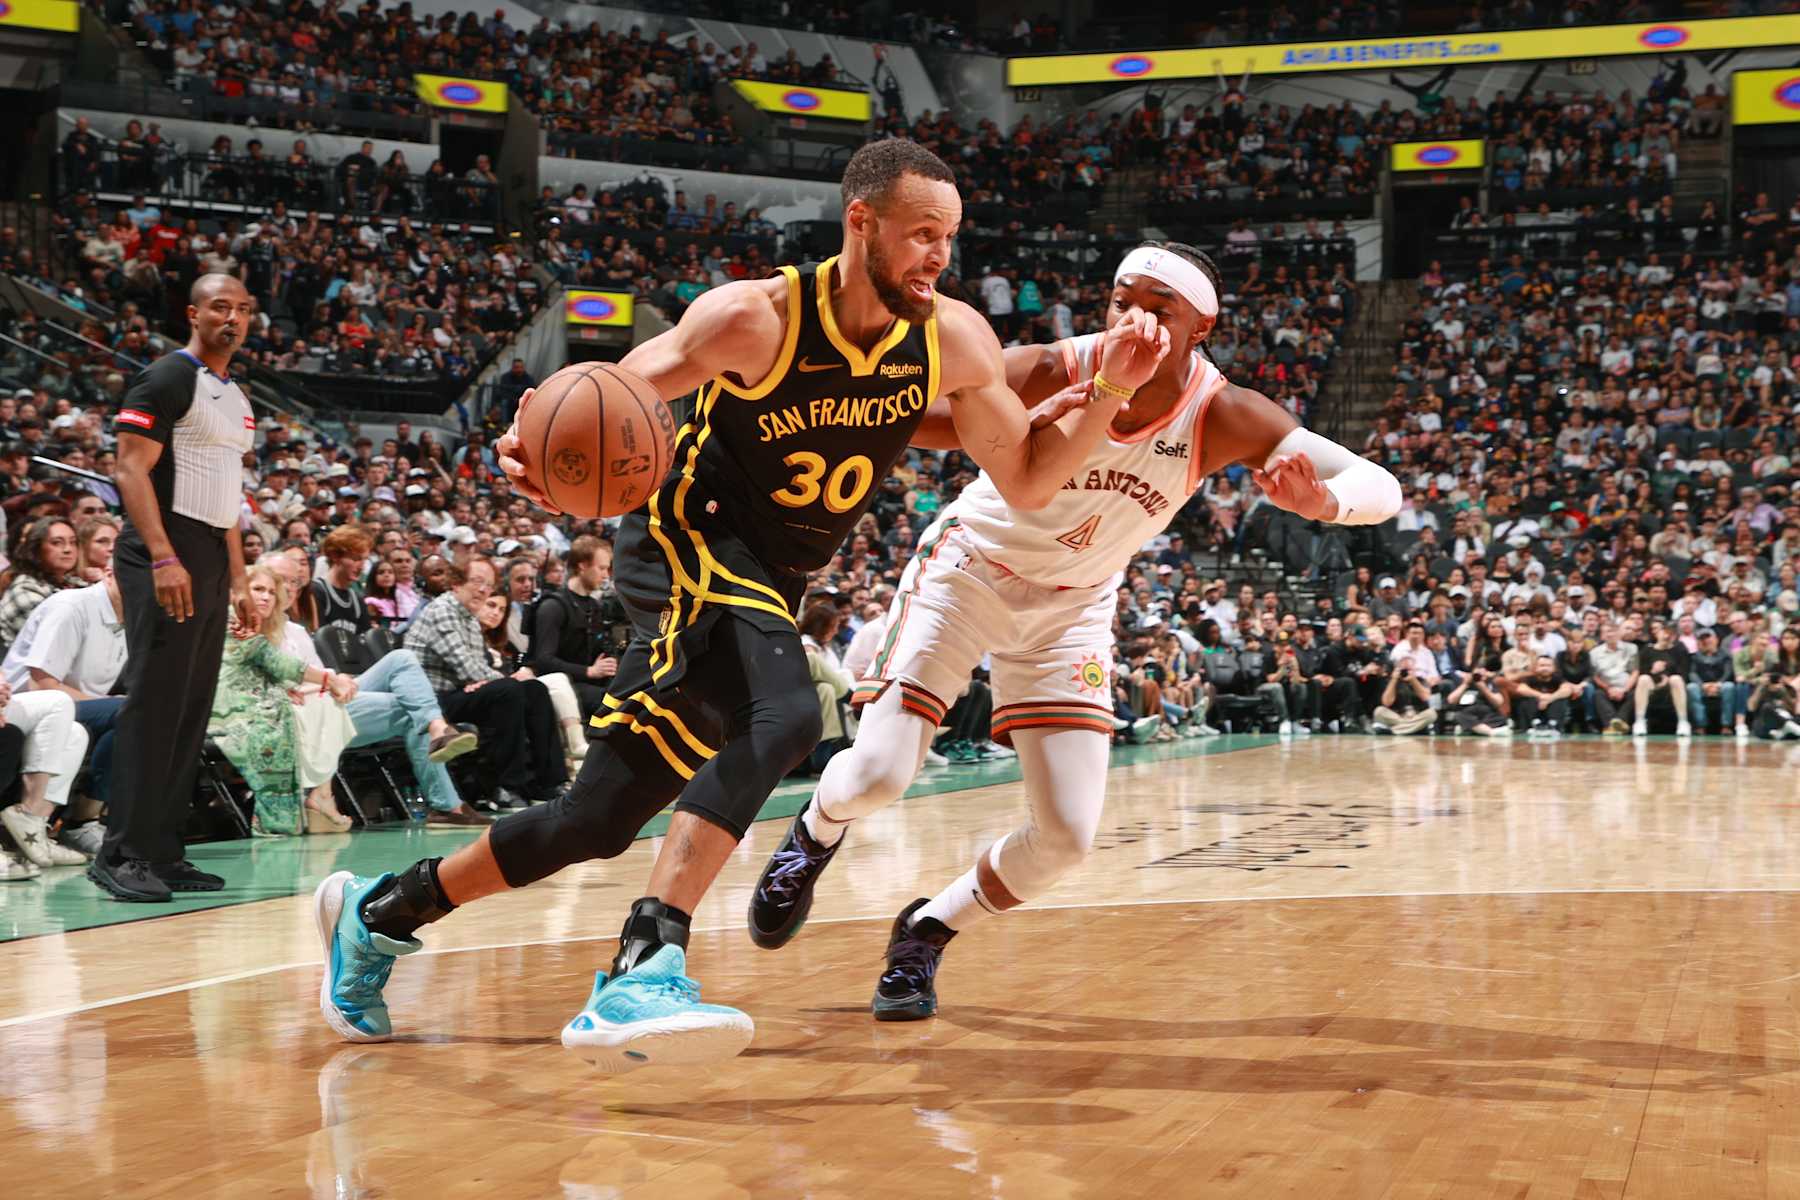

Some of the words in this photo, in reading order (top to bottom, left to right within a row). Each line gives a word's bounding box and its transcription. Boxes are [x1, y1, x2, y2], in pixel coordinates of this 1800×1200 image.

[880, 363, 923, 377] Rakuten
[758, 406, 807, 442] SAN
[809, 384, 923, 427] FRANCISCO
[1154, 440, 1188, 459] Self.
[770, 451, 874, 514] 30
[1055, 514, 1102, 553] 4
